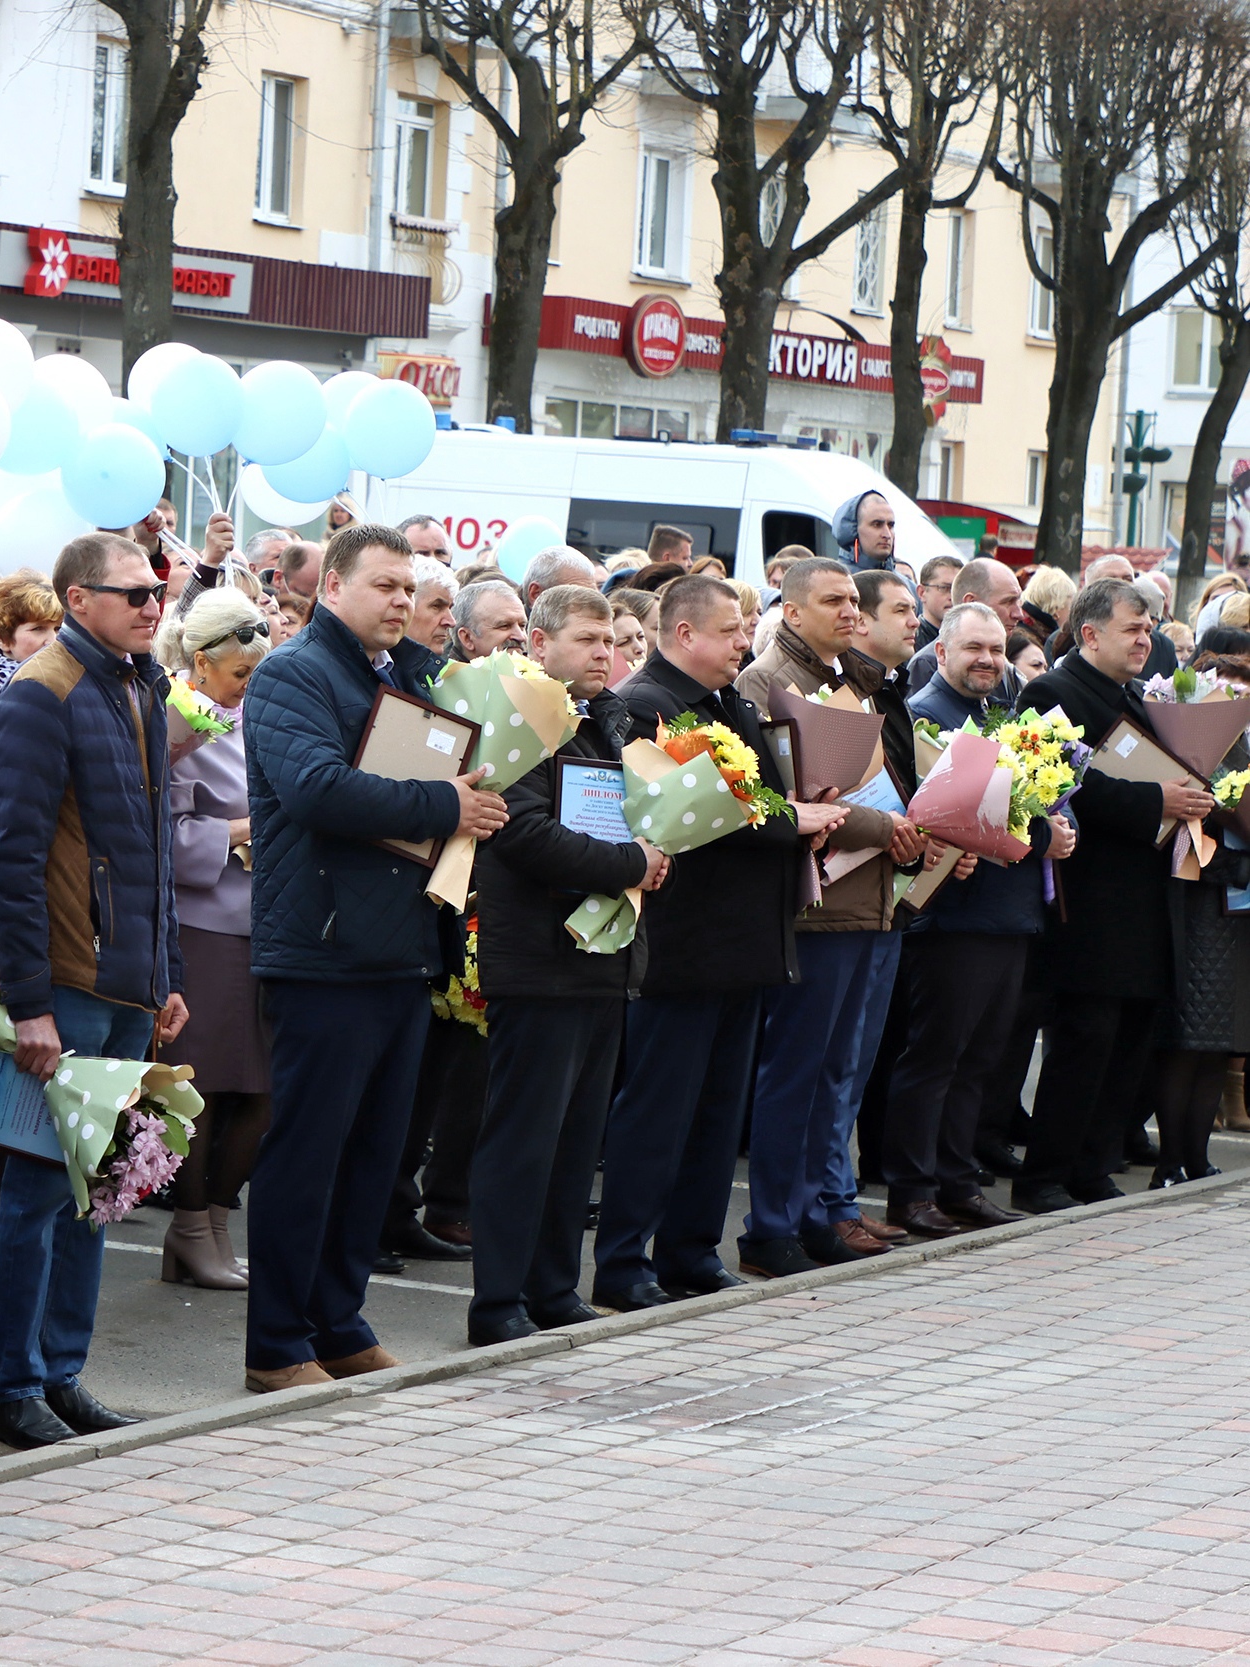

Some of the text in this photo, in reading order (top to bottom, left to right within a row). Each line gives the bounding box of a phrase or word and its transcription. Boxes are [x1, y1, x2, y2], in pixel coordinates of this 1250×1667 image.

[172, 267, 236, 298] РАБЫТ
[573, 314, 621, 340] ПРОДУКТЫ
[768, 334, 858, 383] КТОРИЯ
[581, 789, 623, 800] ДИПЛОМ
